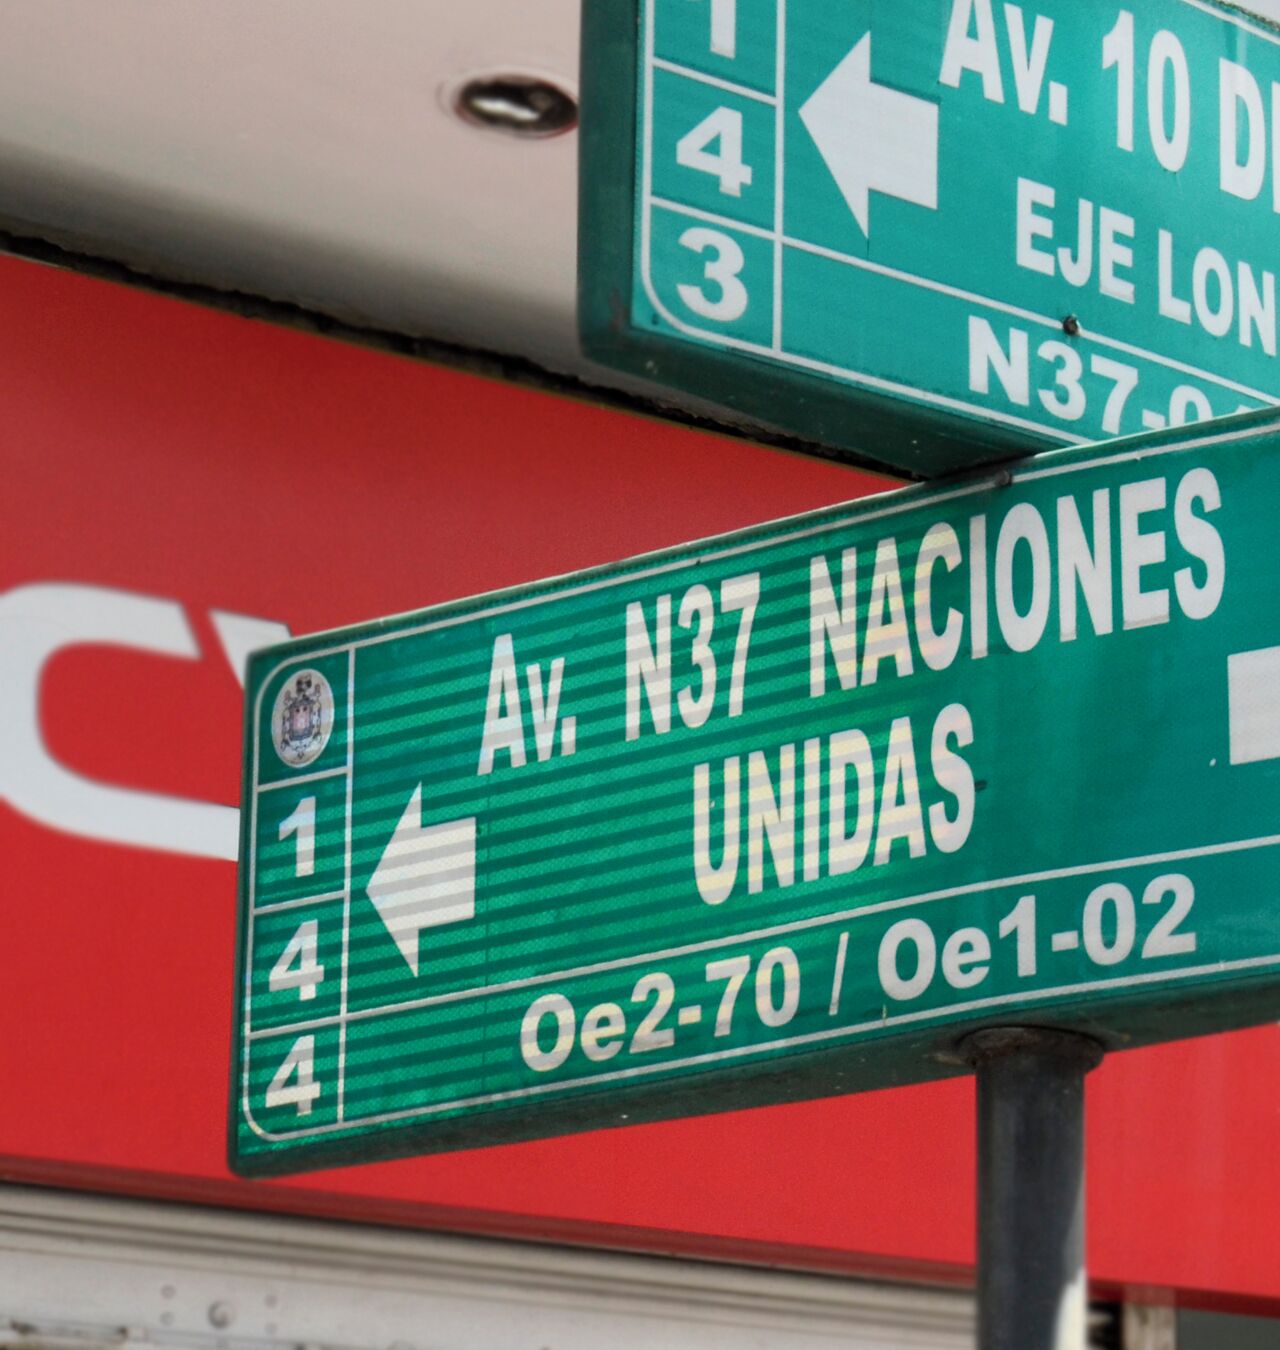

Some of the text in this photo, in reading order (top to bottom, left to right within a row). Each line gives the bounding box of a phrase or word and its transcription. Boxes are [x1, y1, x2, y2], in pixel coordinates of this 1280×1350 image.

[1101, 9, 1191, 172] 10
[676, 106, 752, 198] 4
[676, 227, 748, 321] 3
[1016, 177, 1136, 304] EJE
[968, 316, 1252, 435] N37-
[625, 572, 761, 741] N37
[809, 467, 1227, 698] NACIONES
[278, 796, 317, 877] 1
[692, 703, 977, 905] UNIDAS
[268, 920, 325, 1002] 4
[519, 945, 800, 1073] Oe2-70
[877, 872, 1198, 1001] Oe1-02
[265, 1034, 321, 1115] 4
